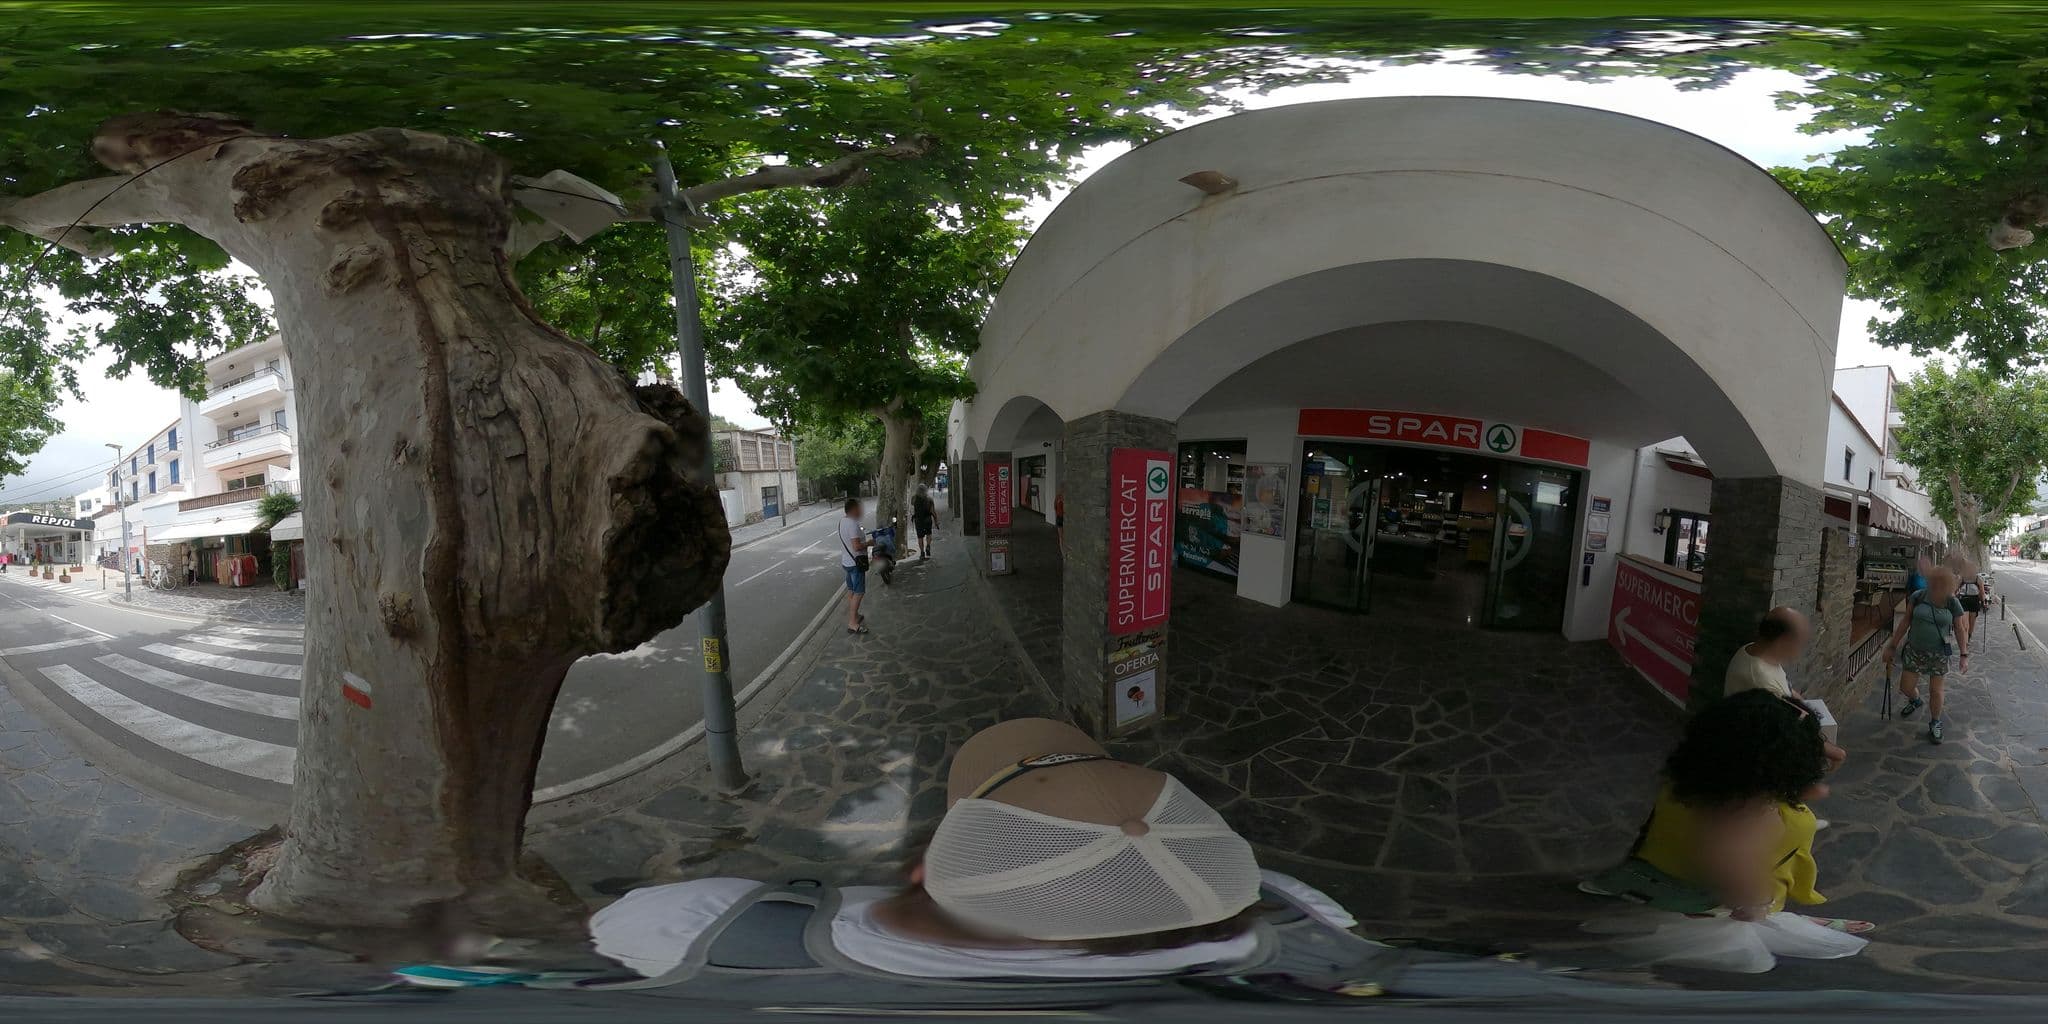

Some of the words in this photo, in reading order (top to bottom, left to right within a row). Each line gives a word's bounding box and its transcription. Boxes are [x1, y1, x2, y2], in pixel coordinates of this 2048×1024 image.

[1367, 415, 1479, 444] SPAR
[988, 471, 999, 525] SUPERMERCAT
[1000, 480, 1009, 513] SPAR
[32, 515, 77, 528] REPSOL
[1886, 505, 1925, 538] HOSTAL
[1118, 474, 1138, 625] SUPERMERCAT
[1148, 501, 1164, 592] SPAR
[1114, 652, 1160, 675] OFERTA
